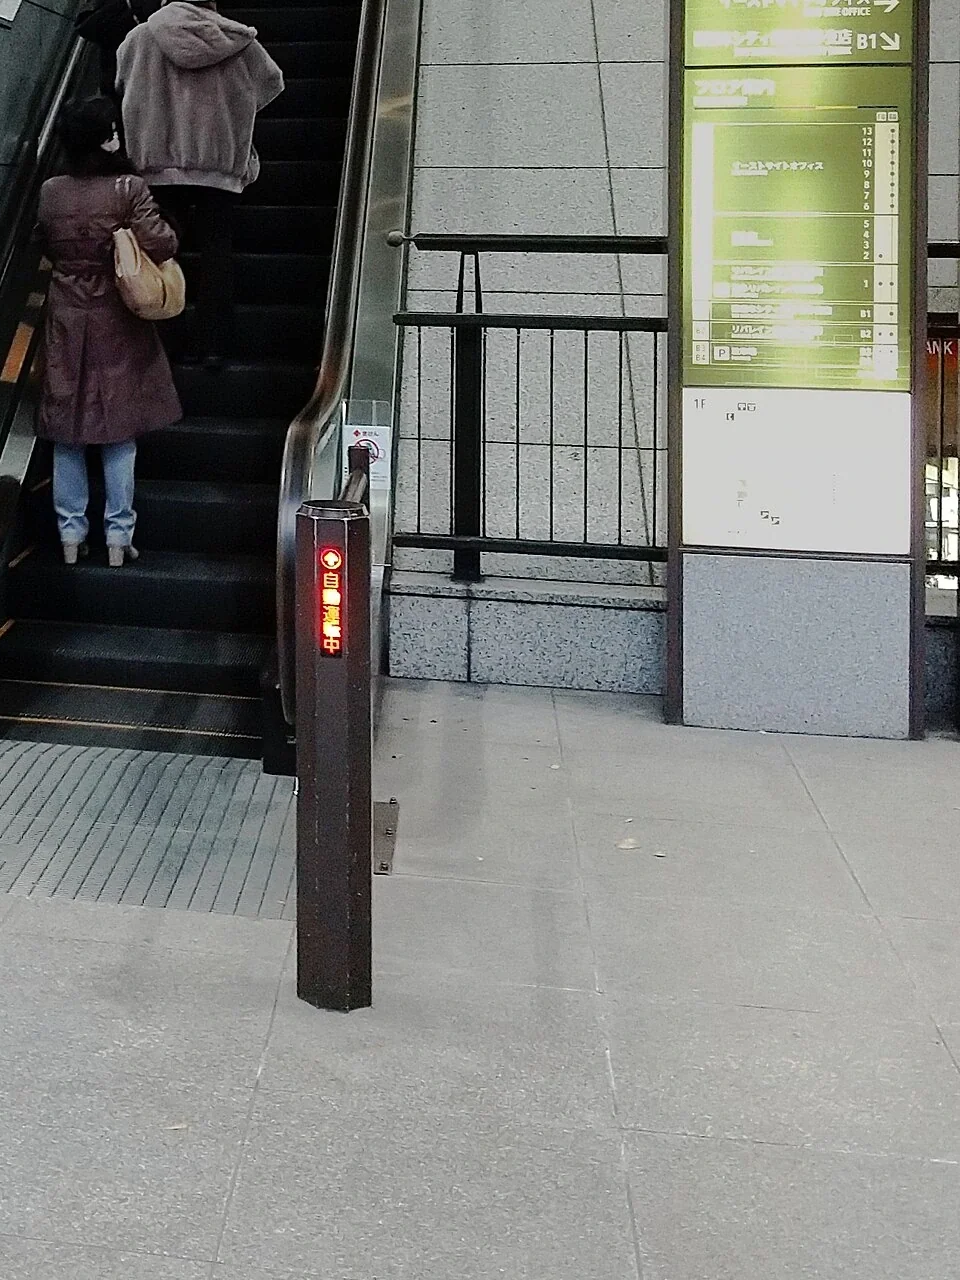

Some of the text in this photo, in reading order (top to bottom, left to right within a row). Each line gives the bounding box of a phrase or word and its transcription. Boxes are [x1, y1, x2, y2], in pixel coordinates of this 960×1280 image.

[857, 33, 877, 50] B1
[862, 127, 873, 136] 13
[862, 138, 873, 147] 12
[862, 148, 872, 157] 11
[862, 159, 873, 168] 10
[864, 170, 870, 179] 9
[864, 181, 870, 189] 8
[864, 192, 870, 200] 7
[864, 202, 870, 211] 6
[863, 220, 870, 228] 5
[863, 231, 870, 239] 4
[863, 241, 870, 250] 3
[863, 252, 870, 260] 2
